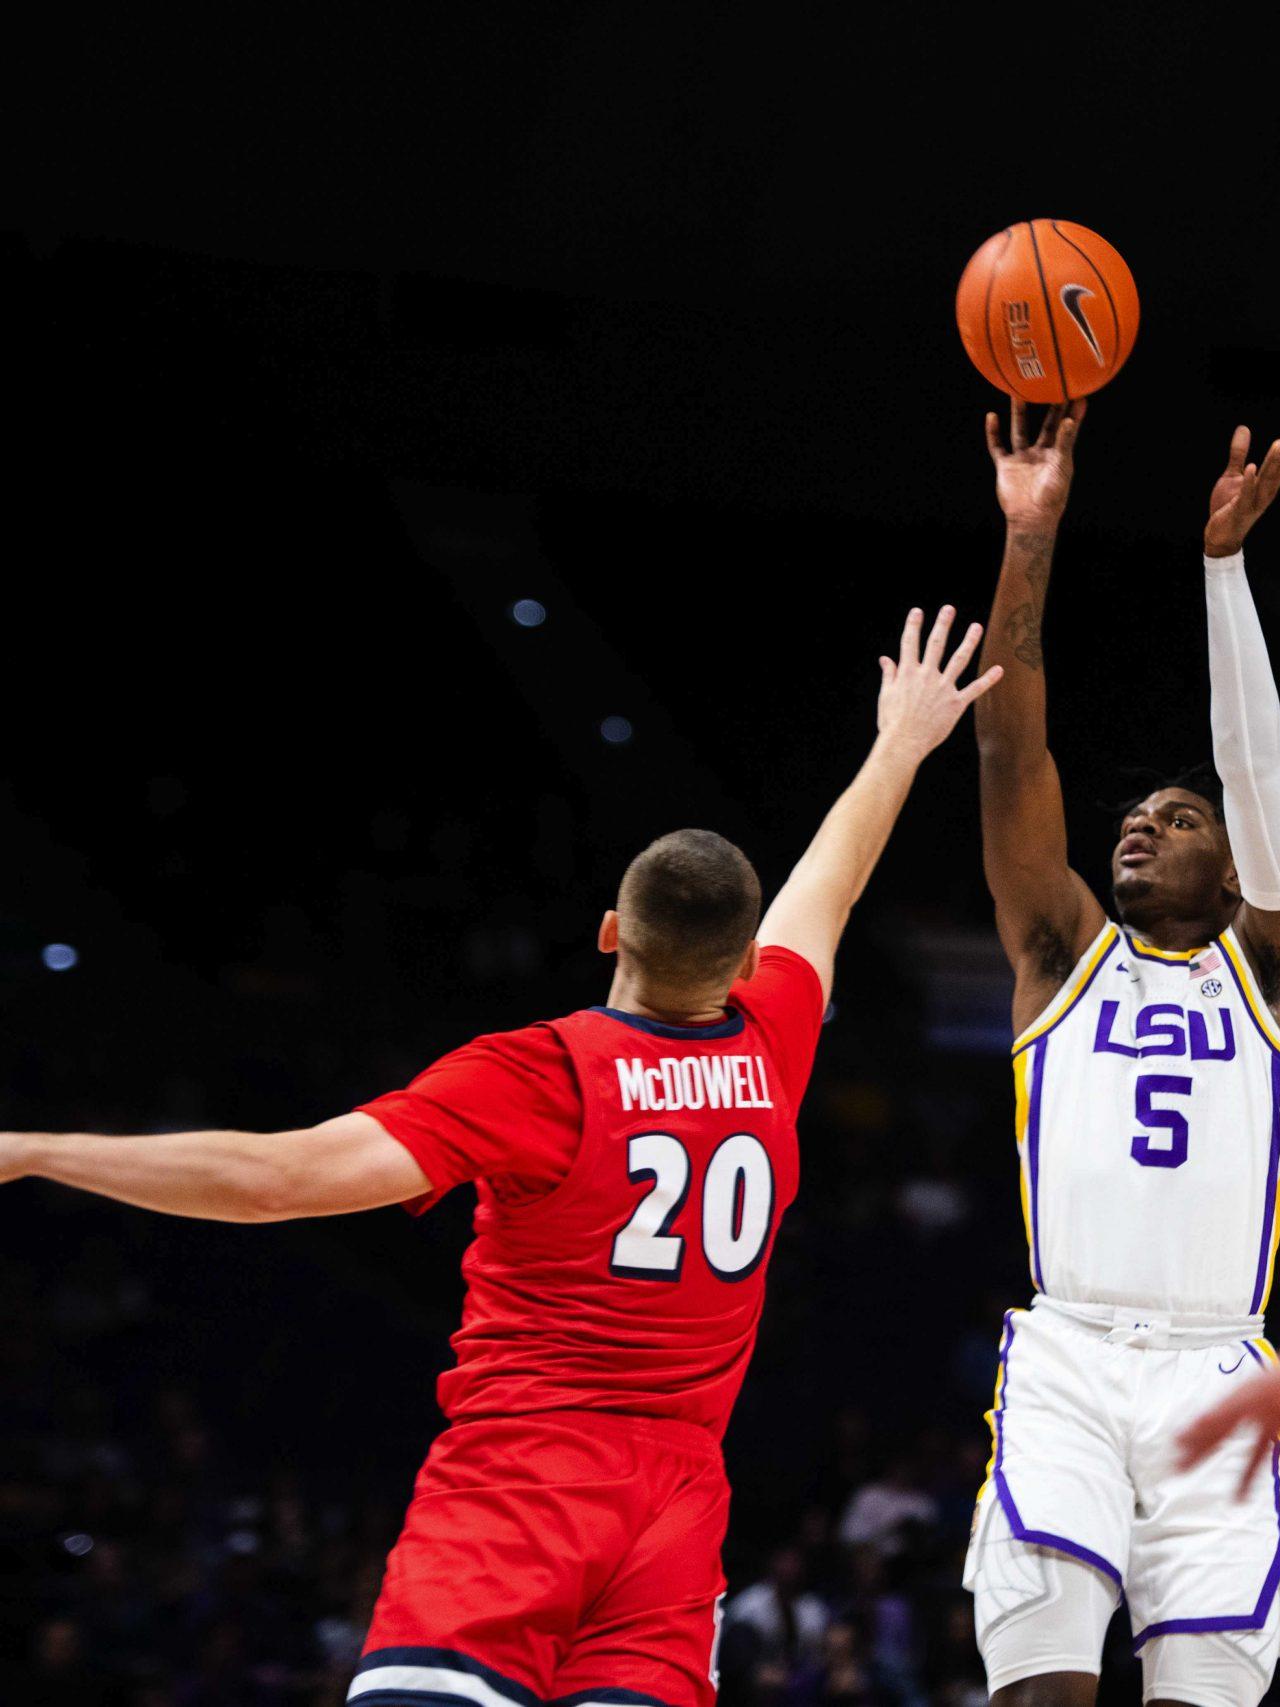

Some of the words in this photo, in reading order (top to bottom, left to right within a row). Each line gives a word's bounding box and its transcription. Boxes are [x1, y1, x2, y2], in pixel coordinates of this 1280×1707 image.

[1004, 301, 1046, 380] ELITE
[1093, 1000, 1236, 1061] LSU
[615, 1055, 773, 1111] McDOWELL
[1130, 1075, 1193, 1168] 5
[609, 1130, 775, 1283] 20
